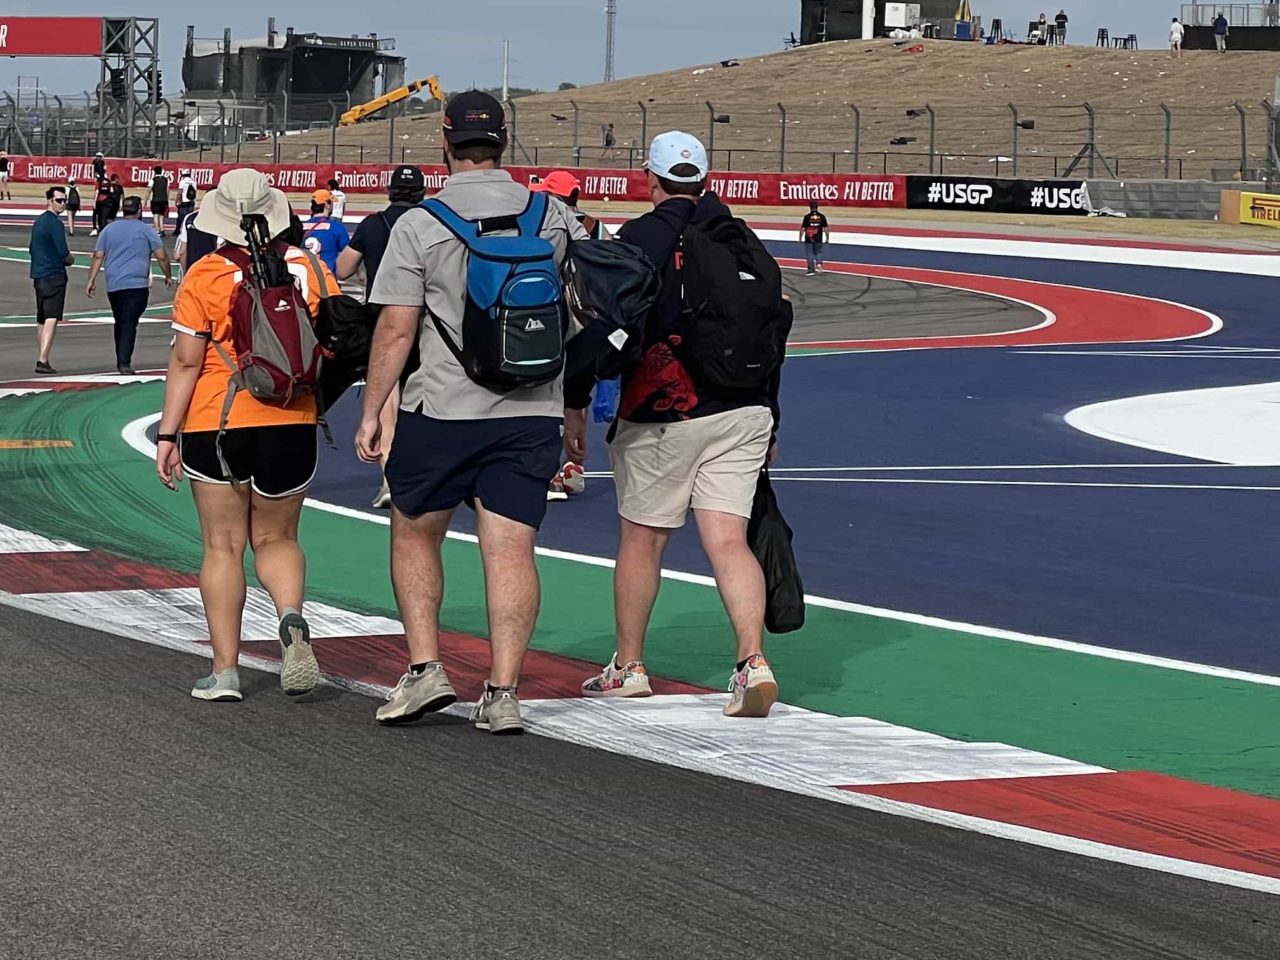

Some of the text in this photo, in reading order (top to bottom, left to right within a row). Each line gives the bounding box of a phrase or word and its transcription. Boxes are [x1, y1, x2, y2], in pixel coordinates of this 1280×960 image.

[28, 163, 67, 179] Emirates
[69, 163, 83, 179] FLY
[277, 170, 292, 187] FLY
[291, 170, 317, 188] BETTER
[334, 169, 378, 188] Emirates
[423, 171, 449, 189] mira
[585, 176, 628, 195] FLY BETTER
[710, 179, 759, 199] FLY BETTER
[779, 181, 894, 201] Emirates FLY BETTER
[928, 183, 993, 205] #USGP
[1030, 187, 1082, 209] #USG
